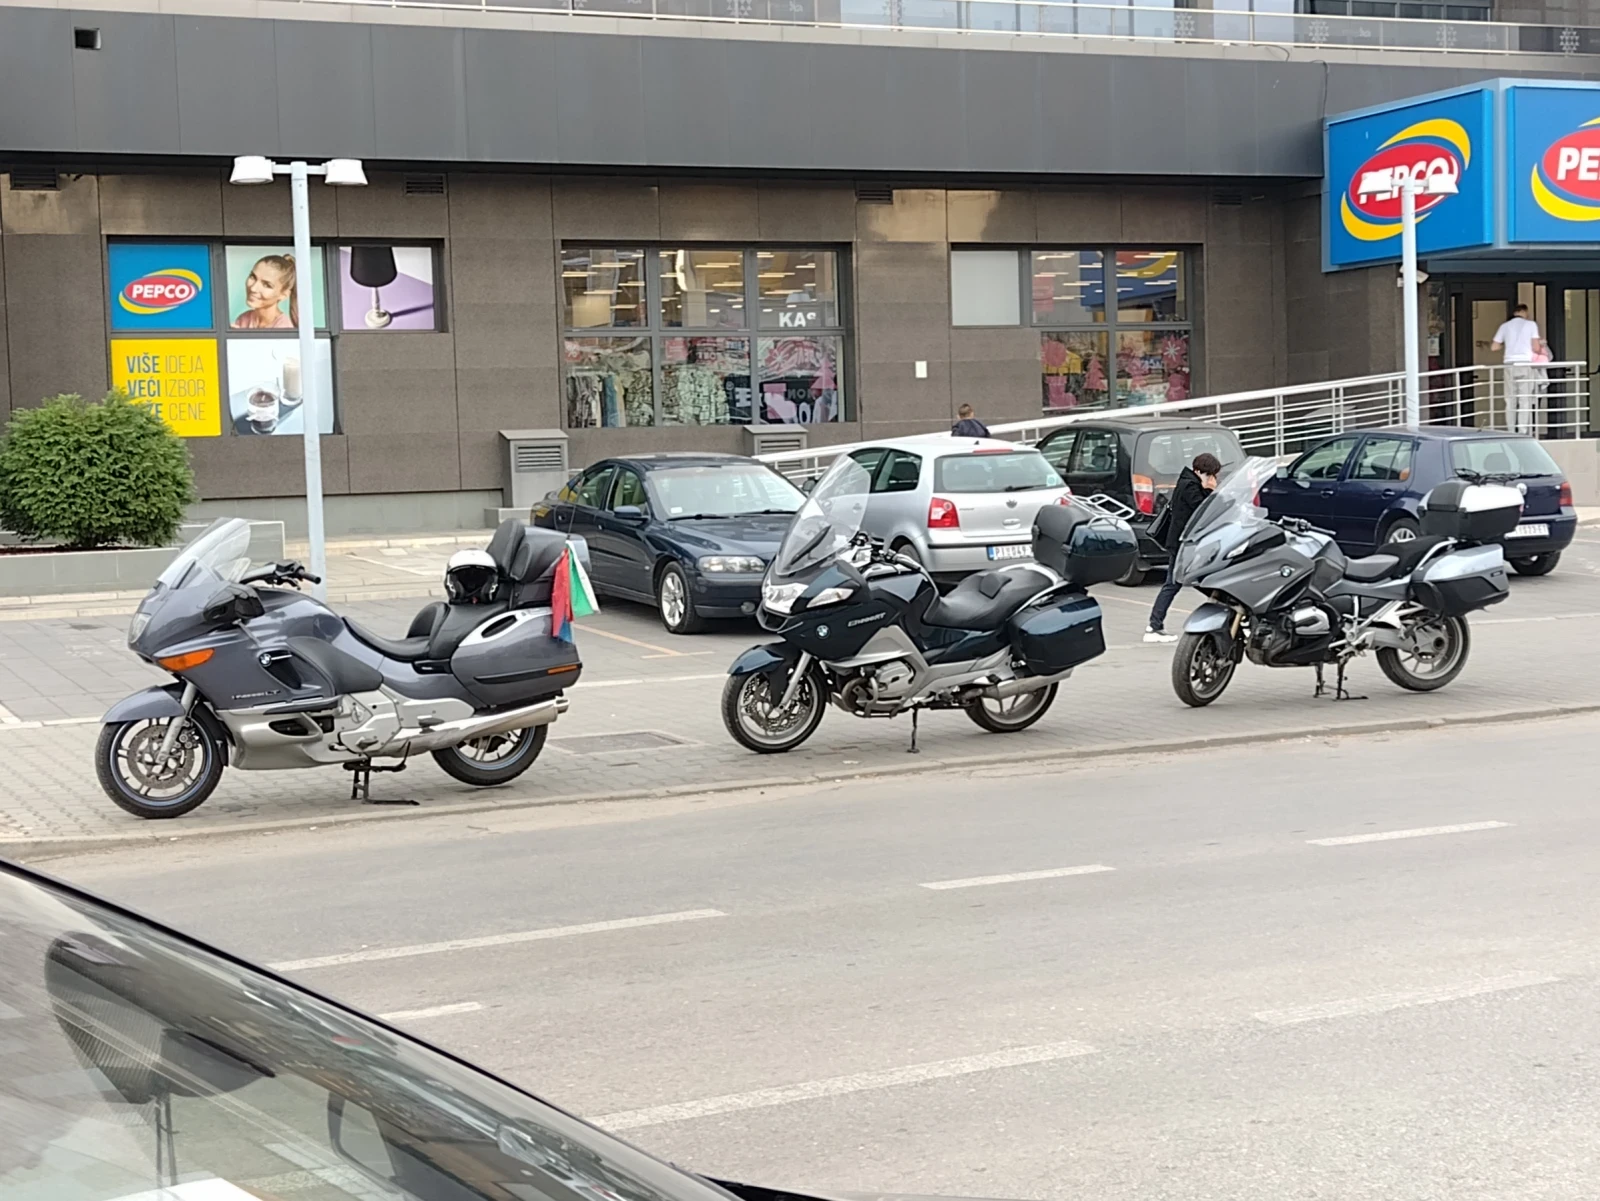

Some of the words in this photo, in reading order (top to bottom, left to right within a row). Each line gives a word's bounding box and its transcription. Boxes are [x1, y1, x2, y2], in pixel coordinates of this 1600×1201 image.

[131, 284, 190, 299] PEPCO
[126, 352, 161, 374] VIŠE
[165, 355, 205, 374] IDEJA
[127, 376, 161, 397] VEĆI
[165, 379, 206, 397] IZBOR
[169, 402, 206, 421] CENE
